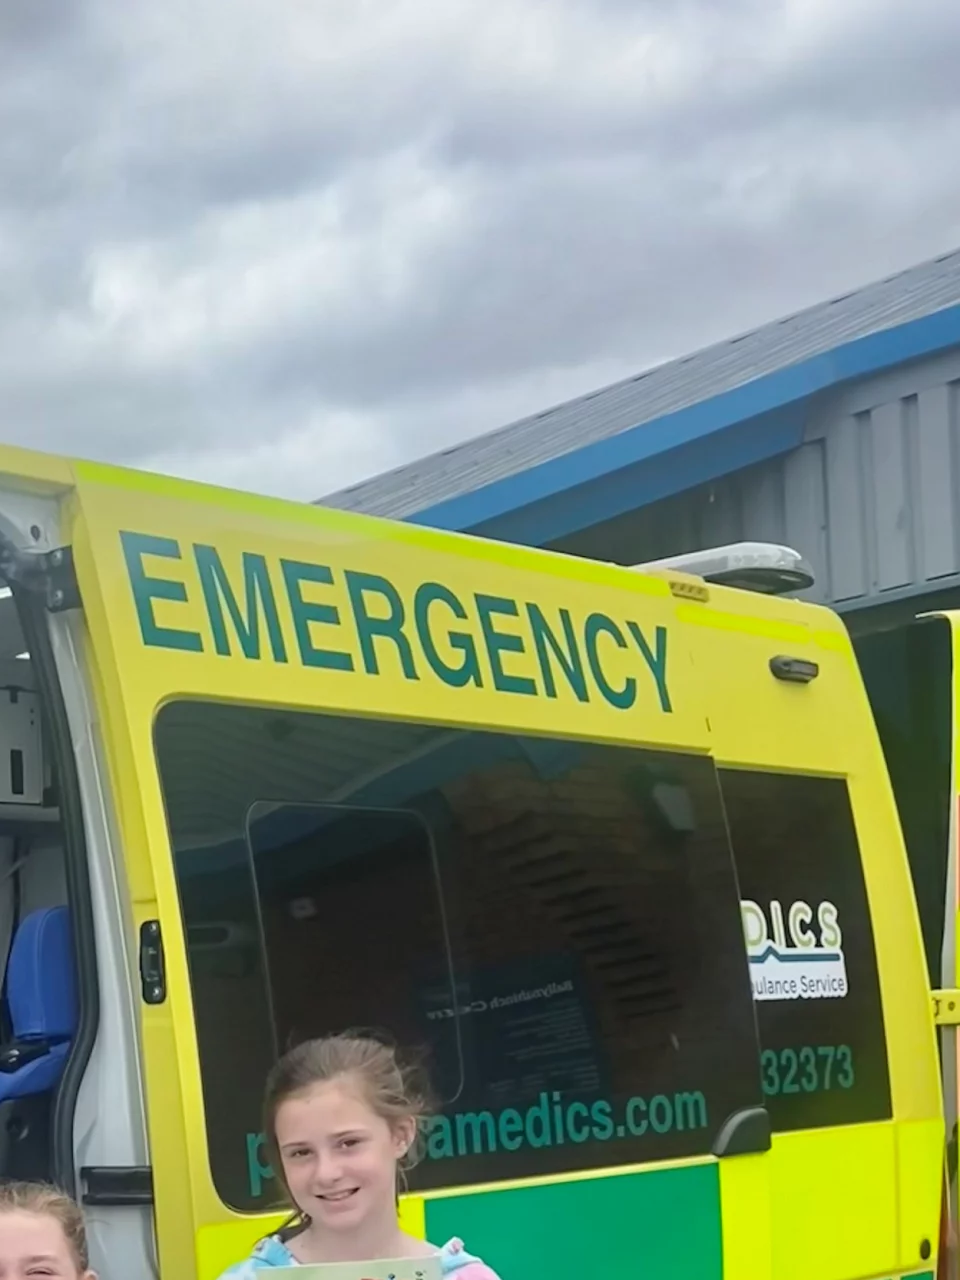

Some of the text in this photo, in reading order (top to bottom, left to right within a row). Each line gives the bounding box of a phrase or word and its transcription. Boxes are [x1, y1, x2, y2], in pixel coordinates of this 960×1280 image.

[119, 529, 673, 713] EMERGENCY
[800, 974, 845, 993] Service
[761, 1045, 855, 1095] 32373
